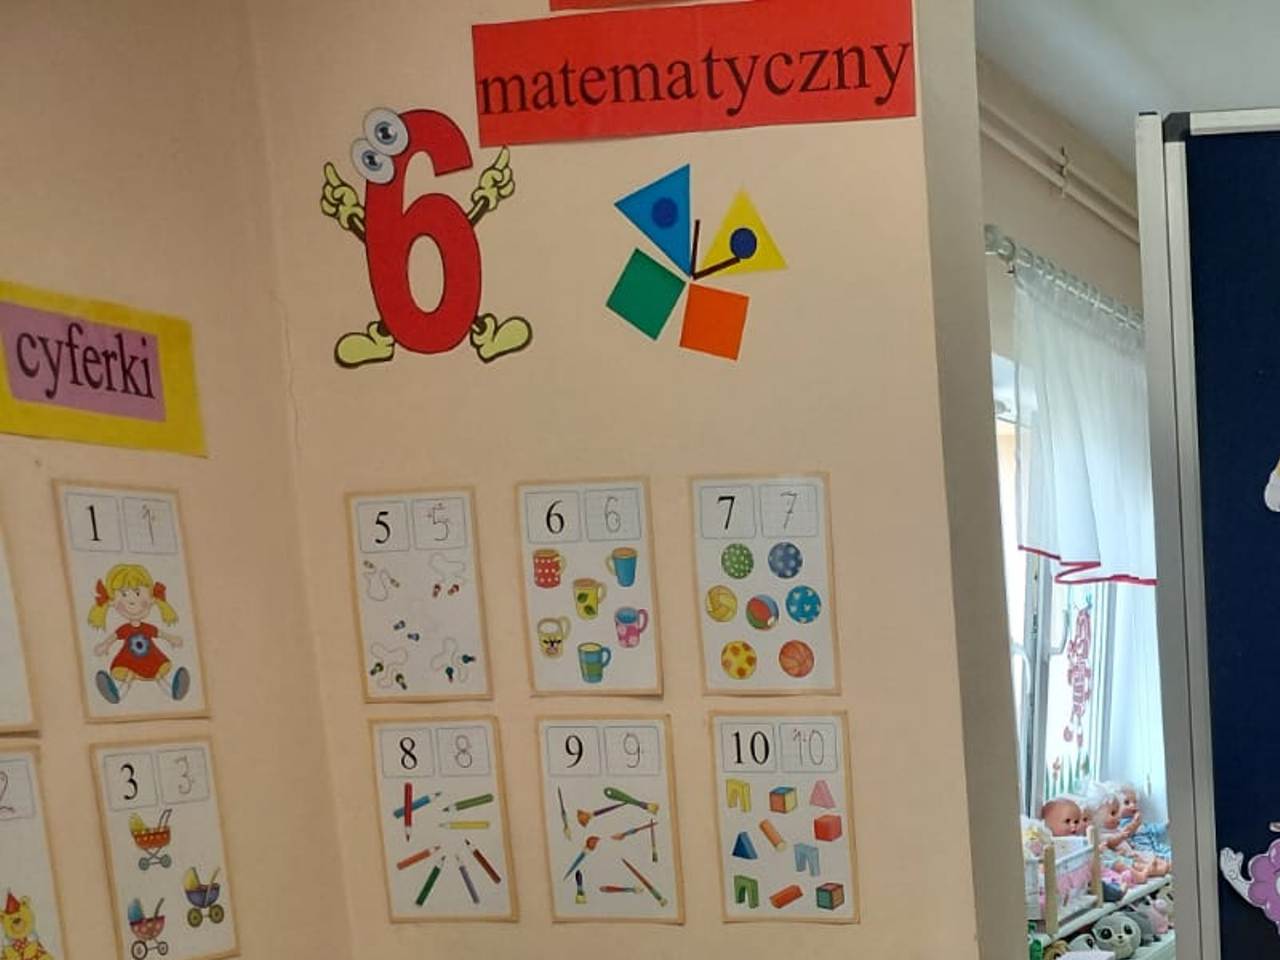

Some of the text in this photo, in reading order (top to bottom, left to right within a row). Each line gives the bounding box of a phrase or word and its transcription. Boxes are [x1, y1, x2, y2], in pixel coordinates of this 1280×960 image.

[480, 41, 911, 117] matematyczny
[365, 109, 482, 355] 6
[16, 322, 156, 400] cyferki
[86, 504, 101, 542] 1
[375, 511, 391, 544] 5
[545, 497, 621, 535] 6 6
[717, 490, 798, 530] 7 7
[399, 735, 473, 770] 8 8
[565, 733, 642, 768] 9 9
[732, 730, 769, 766] 10
[120, 756, 195, 800] 3 3
